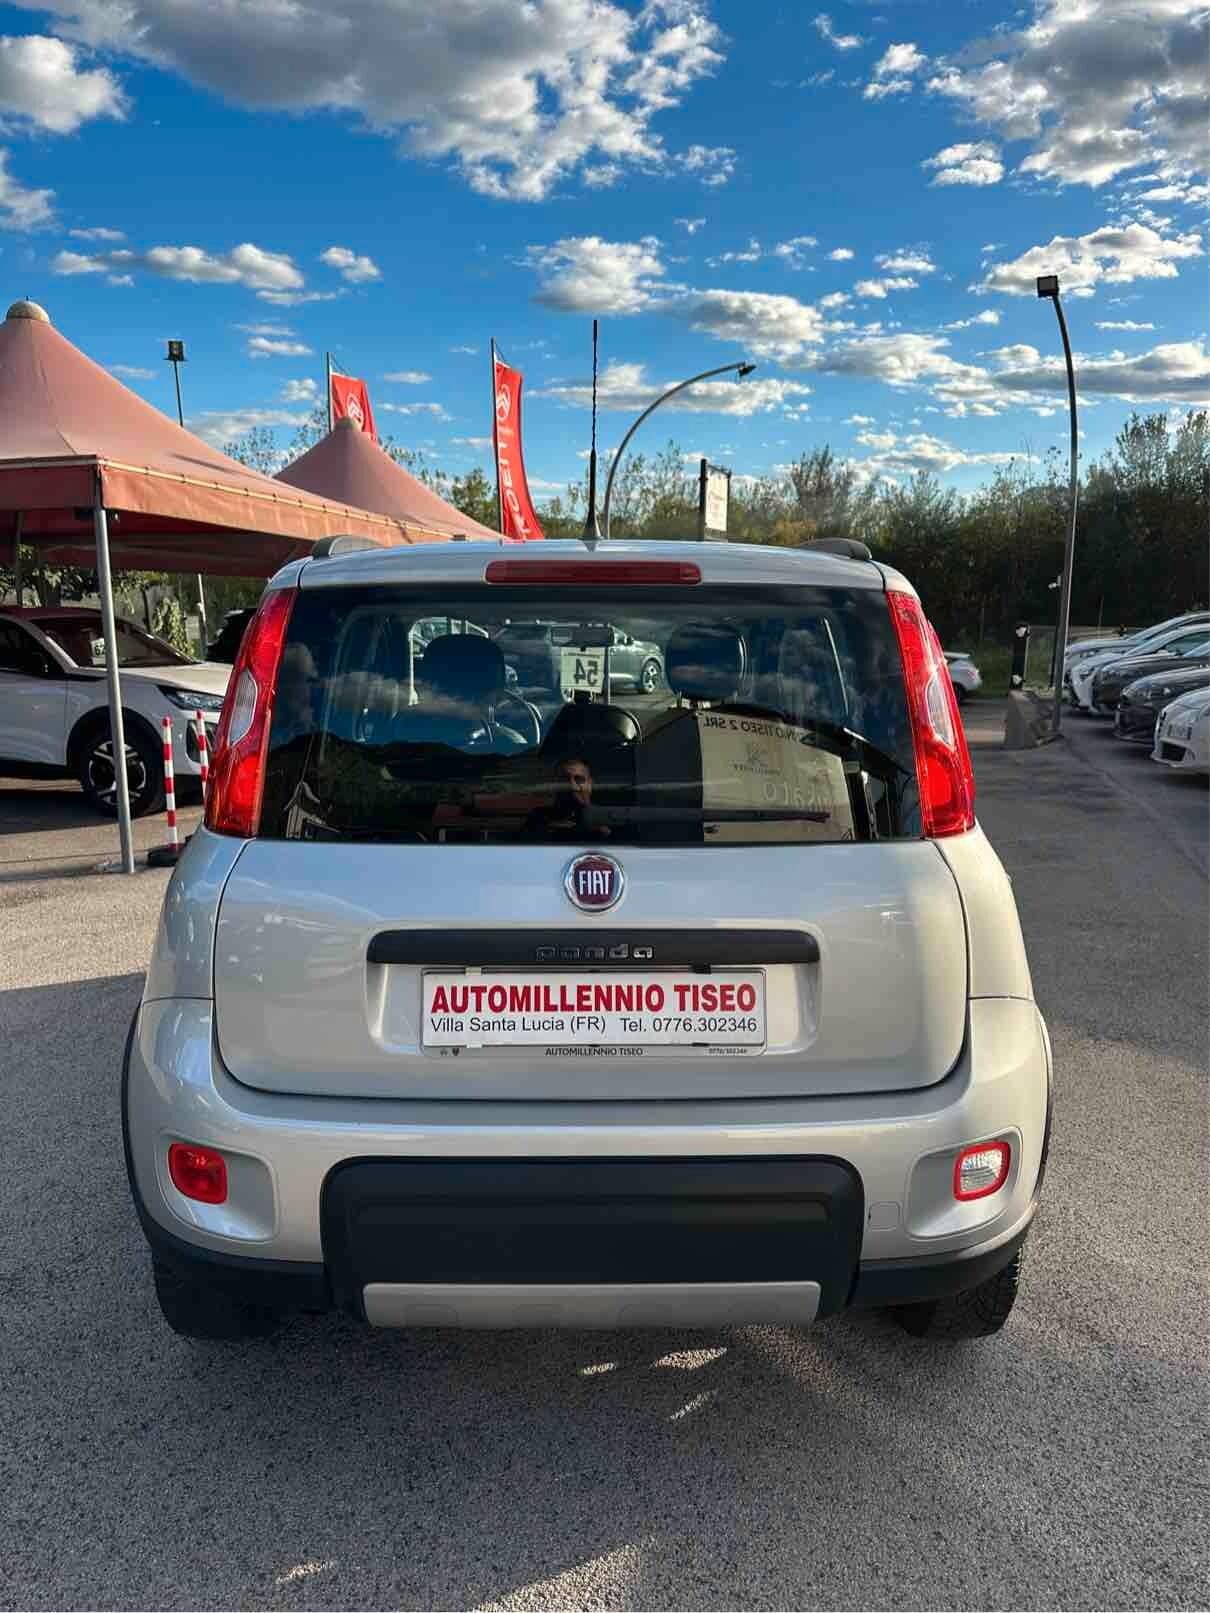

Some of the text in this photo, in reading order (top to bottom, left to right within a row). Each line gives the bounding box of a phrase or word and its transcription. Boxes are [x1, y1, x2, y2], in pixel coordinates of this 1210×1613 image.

[578, 869, 612, 896] FIAT
[536, 943, 653, 961] panda
[431, 983, 757, 1014] AUTOMILLENNIO TISEO
[431, 1015, 757, 1034] Villa Santa Lucia (FR) Tel. 0776.302346
[545, 1047, 618, 1056] AUTOMILLENNIO
[620, 1047, 643, 1056] TISEO
